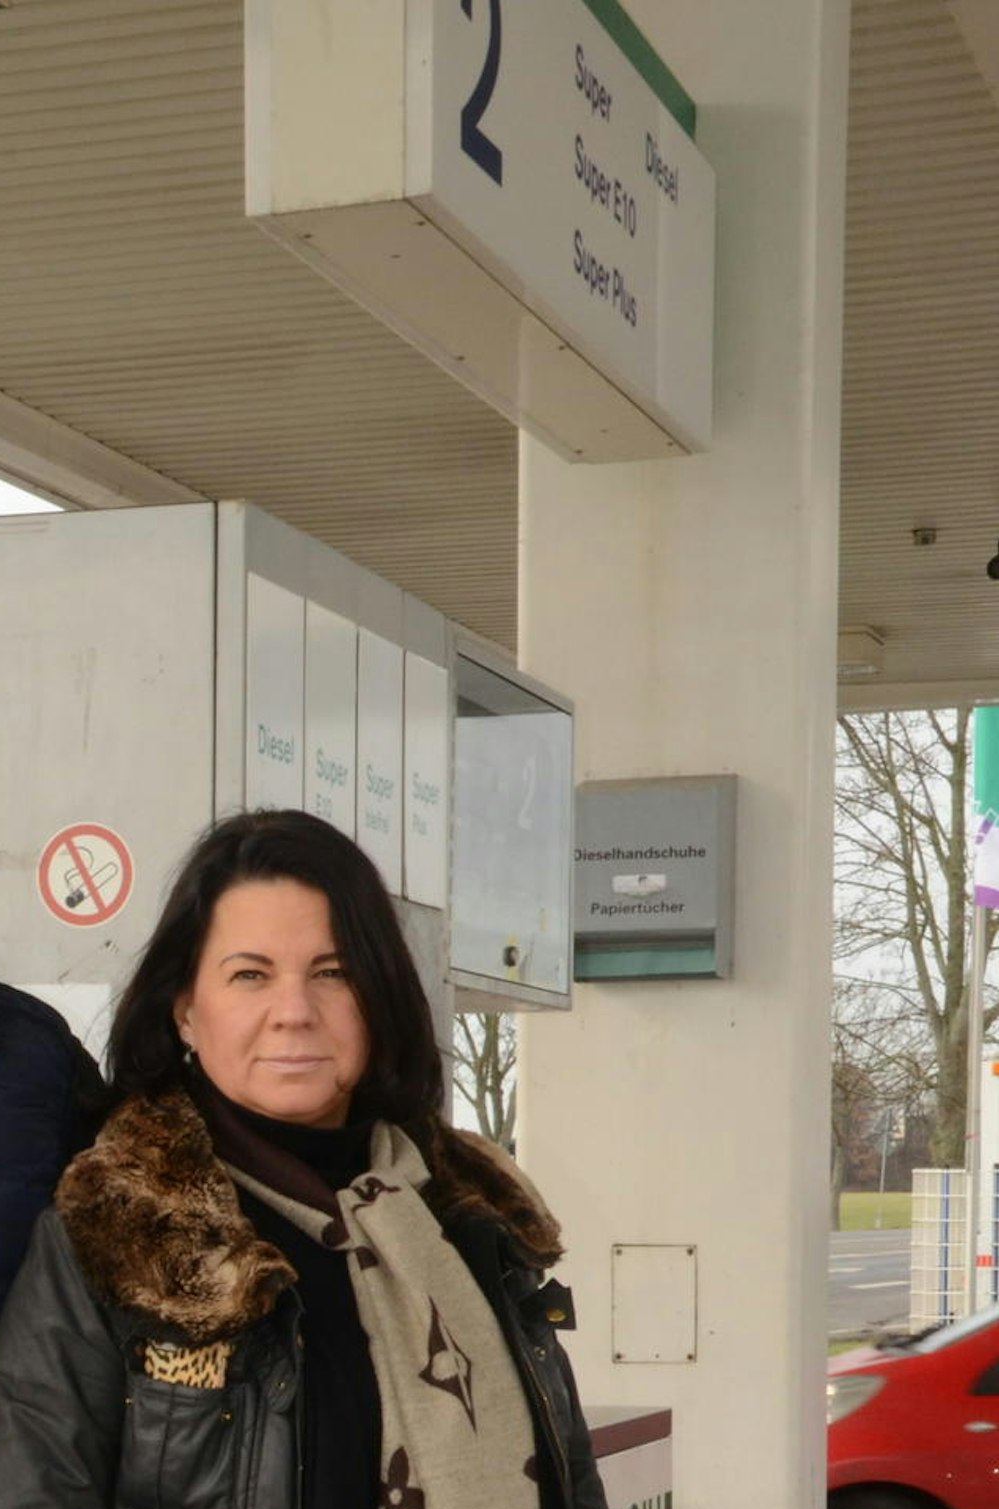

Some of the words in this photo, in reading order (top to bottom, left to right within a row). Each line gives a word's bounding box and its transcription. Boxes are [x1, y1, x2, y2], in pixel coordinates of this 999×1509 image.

[461, 0, 502, 187] 2
[574, 43, 612, 122] Super
[574, 133, 611, 210] Super
[613, 178, 636, 238] E10
[645, 131, 679, 204] Diesel
[573, 229, 611, 301] Super
[612, 267, 637, 327] Plus
[258, 723, 294, 765] Diesel
[315, 748, 349, 787] Super
[365, 764, 395, 800] Super
[412, 772, 440, 807] Super
[573, 845, 707, 862] Dieselhandschuhe
